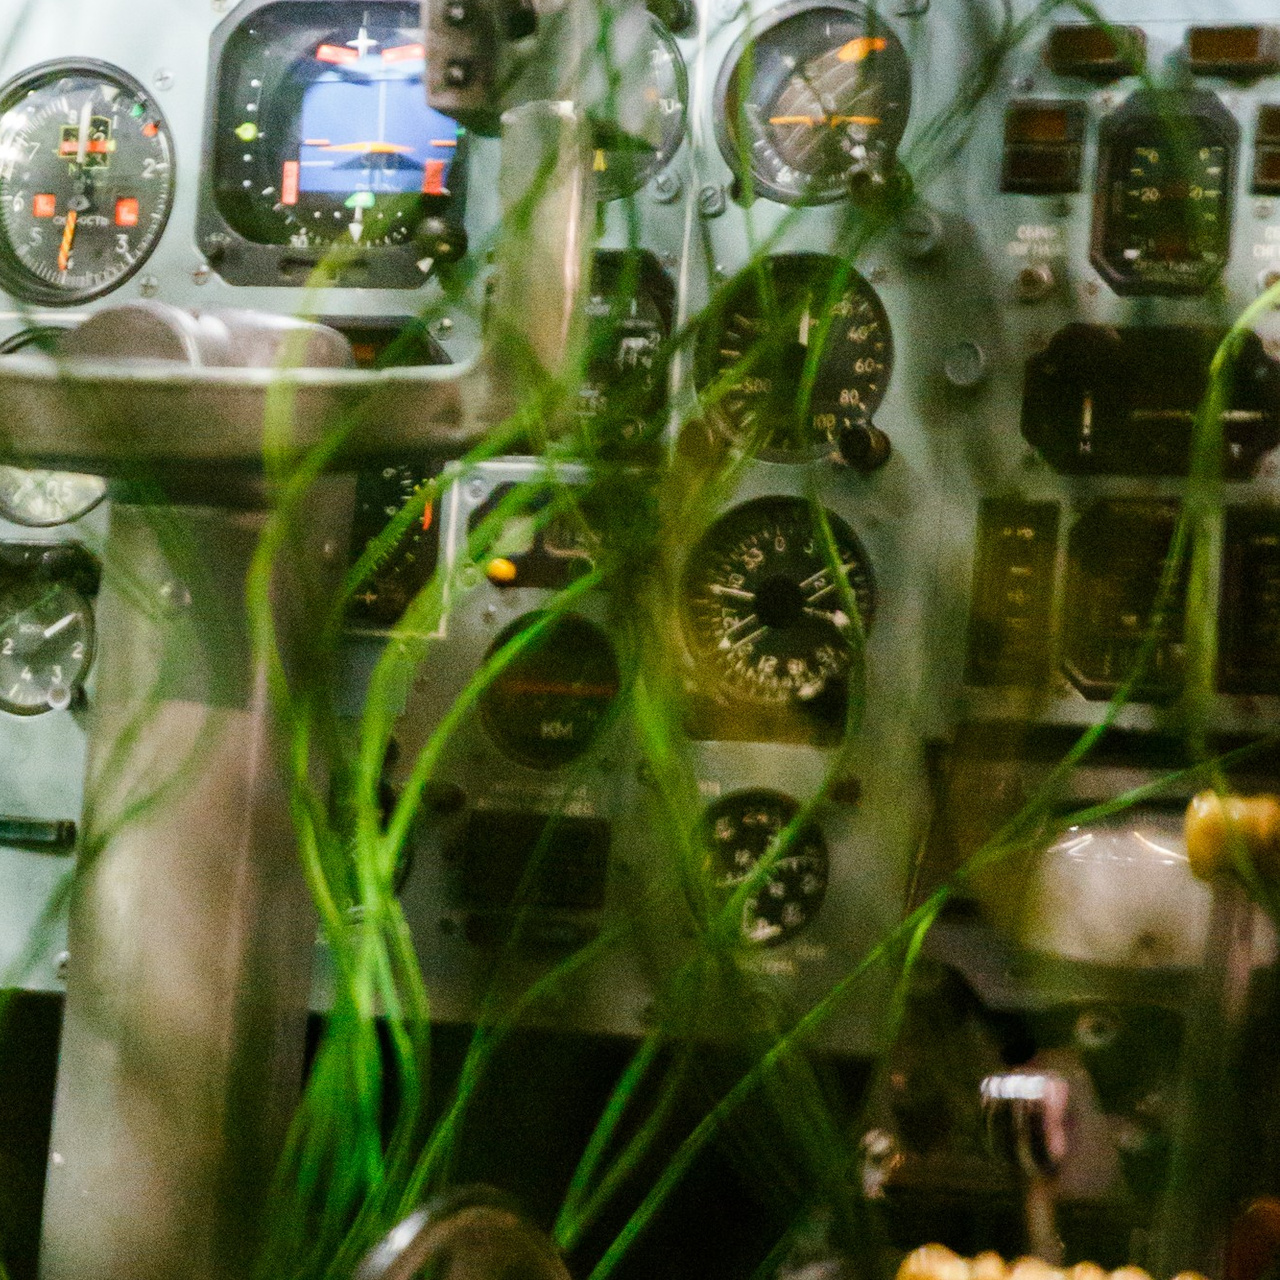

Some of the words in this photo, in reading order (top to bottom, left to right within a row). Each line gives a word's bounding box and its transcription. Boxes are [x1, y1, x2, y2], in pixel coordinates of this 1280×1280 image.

[142, 158, 156, 179] 2
[13, 191, 24, 212] 6
[116, 233, 128, 254] 3
[854, 357, 876, 375] 60
[839, 388, 860, 407] 80
[72, 642, 83, 659] 2
[21, 666, 32, 681] 4
